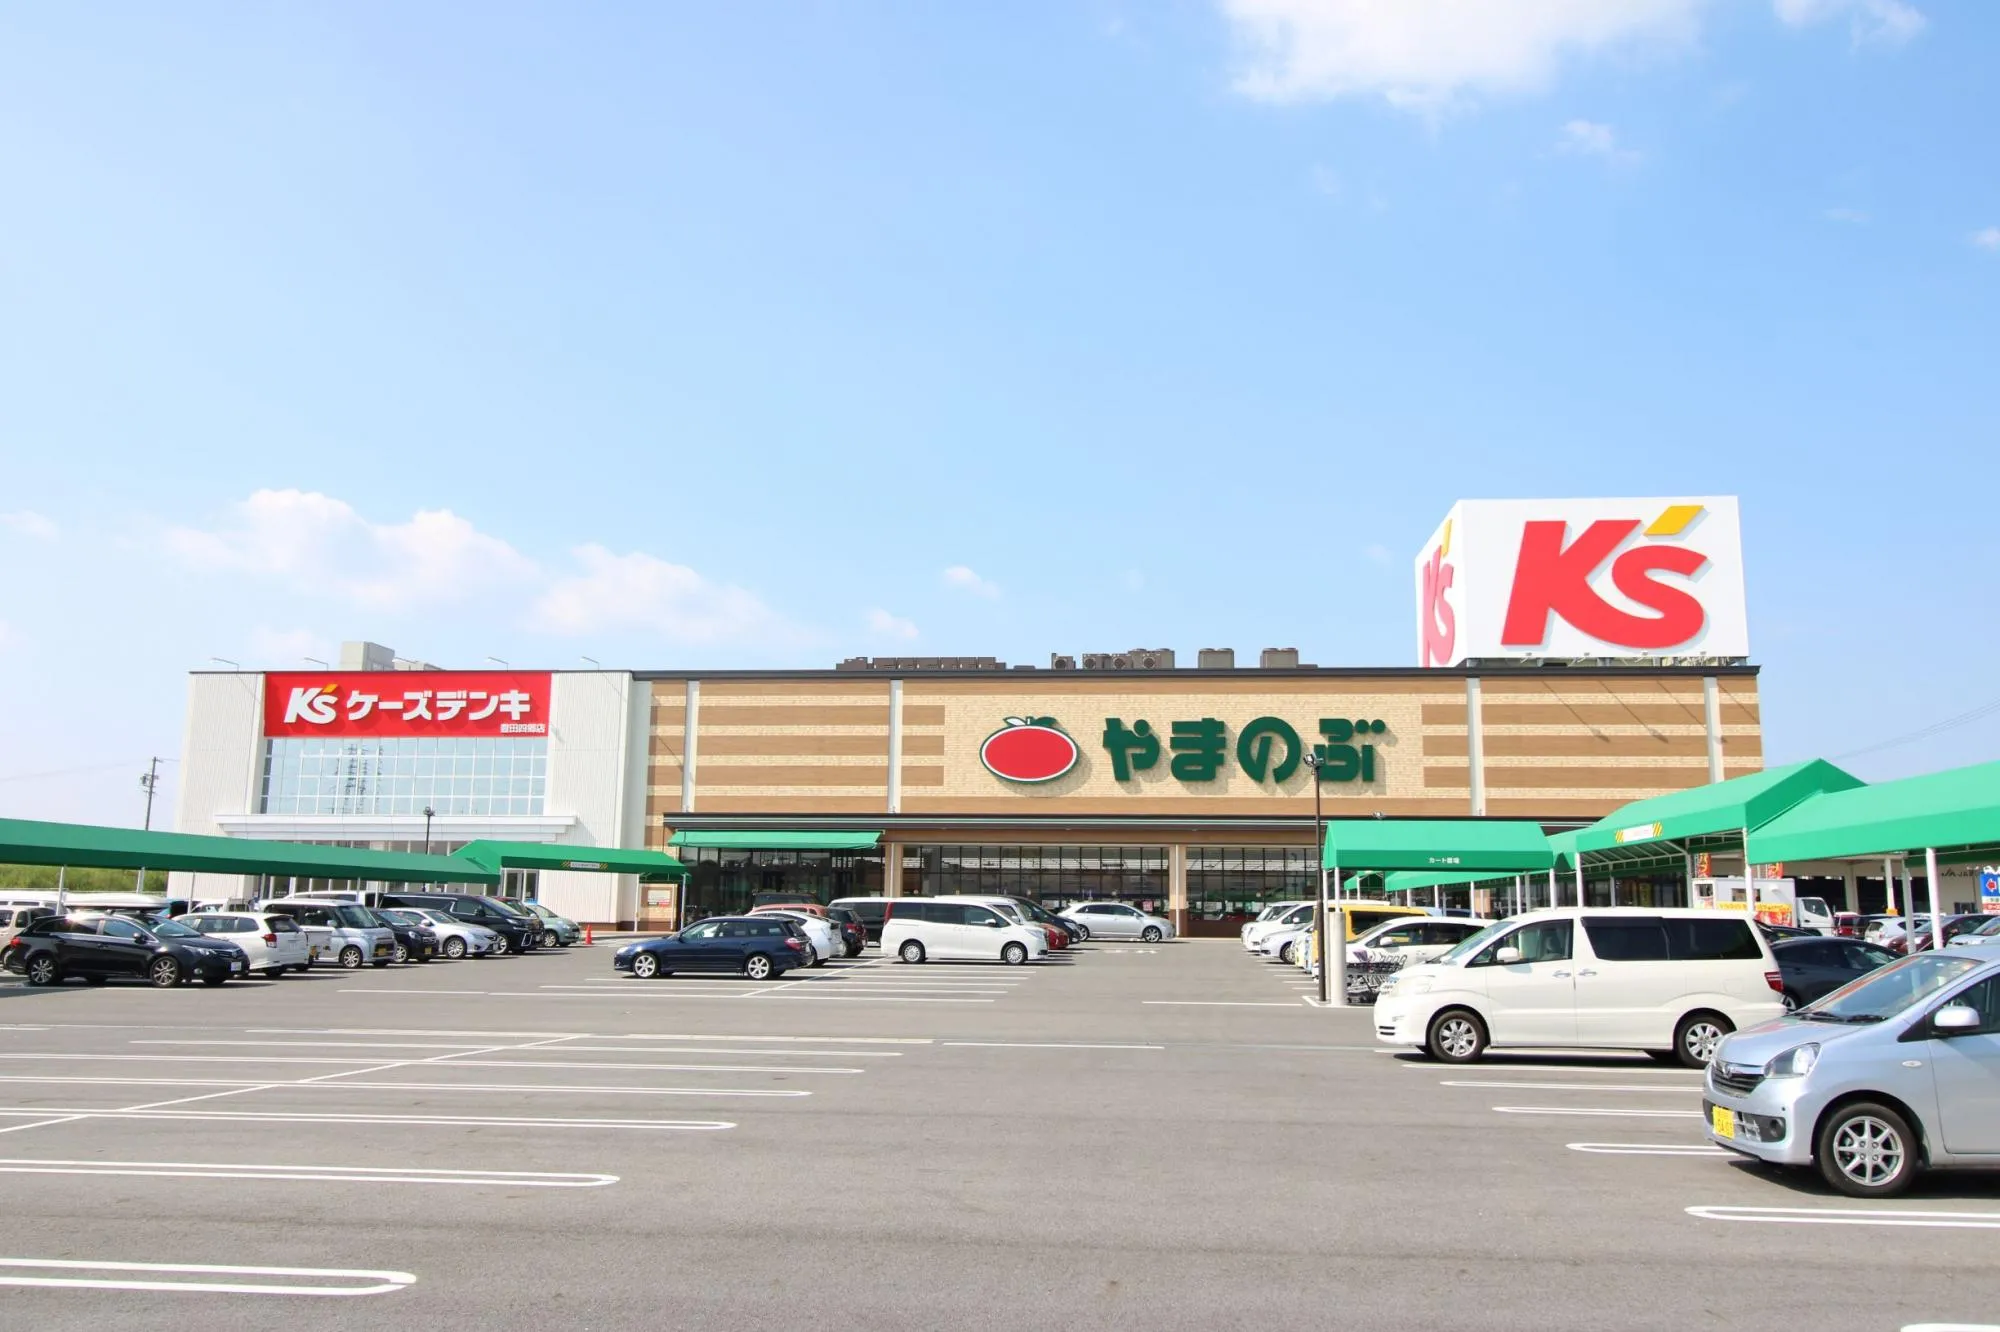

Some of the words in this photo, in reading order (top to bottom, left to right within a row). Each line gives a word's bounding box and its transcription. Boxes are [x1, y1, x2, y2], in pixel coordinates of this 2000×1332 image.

[1500, 504, 1708, 649] K's
[346, 689, 531, 721] ケーズデンキ
[1102, 716, 1386, 784] やまのぶ
